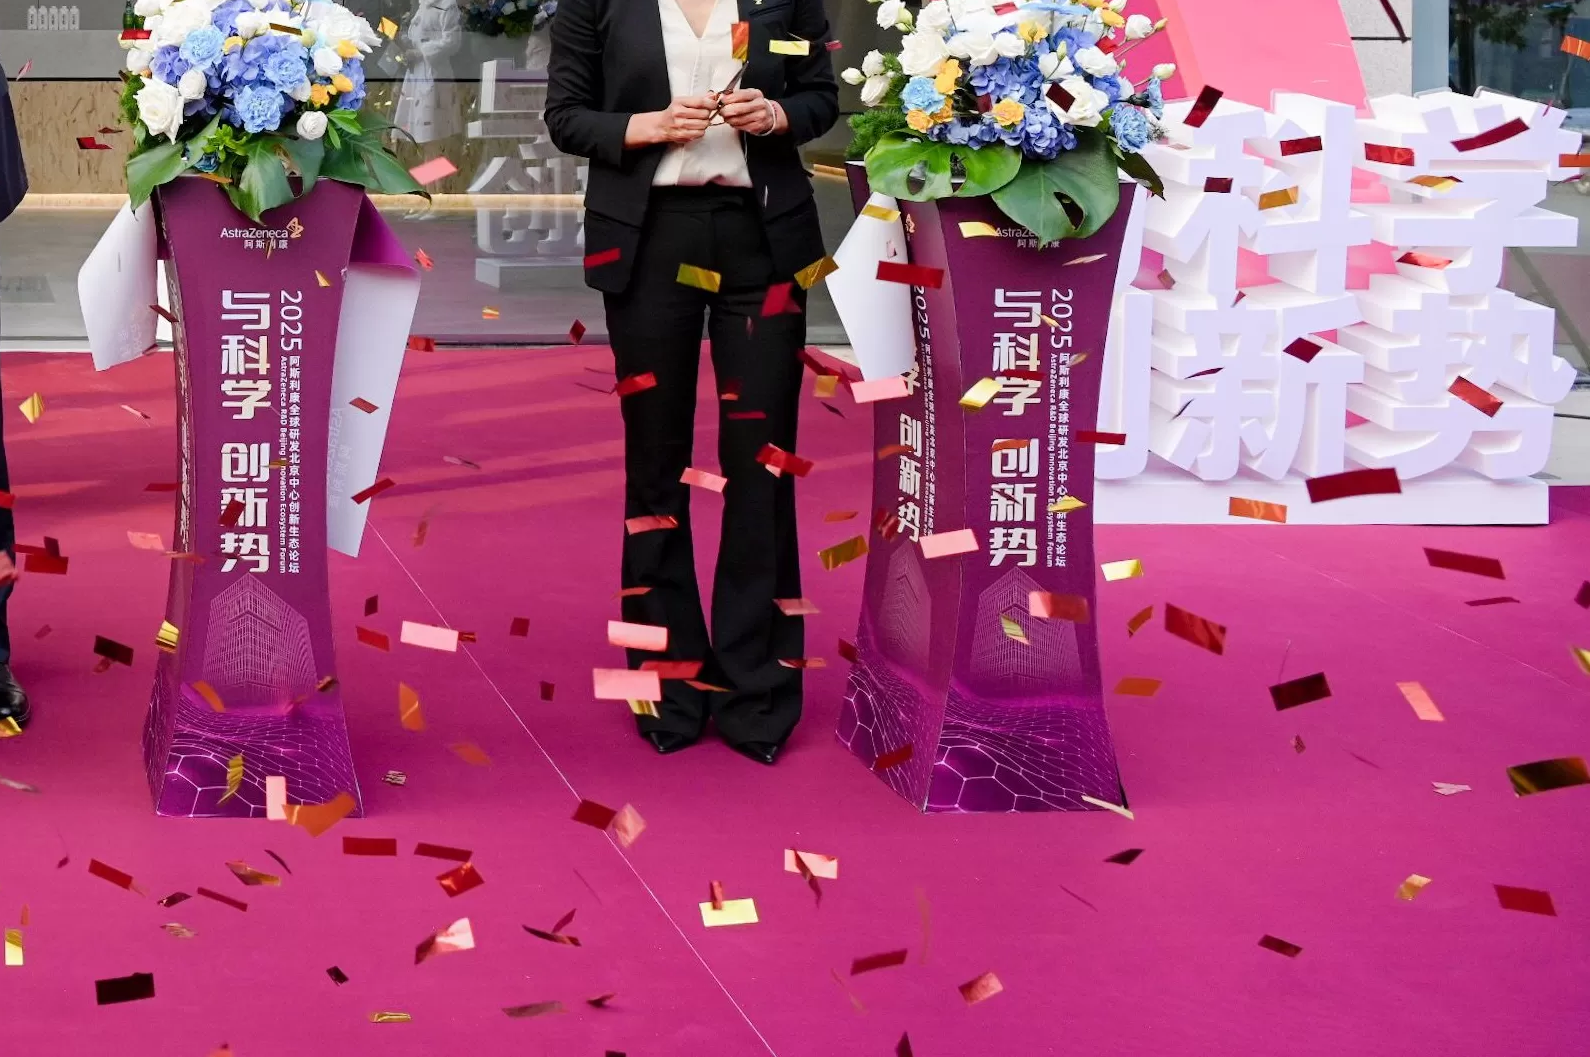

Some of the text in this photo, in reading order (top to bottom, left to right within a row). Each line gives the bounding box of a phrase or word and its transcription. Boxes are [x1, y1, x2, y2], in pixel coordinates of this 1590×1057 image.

[1128, 104, 1579, 296] 科学
[220, 227, 289, 239] AstraZeneca
[1017, 238, 1060, 249] 阿斯康
[280, 356, 288, 407] AstraZeneca
[1049, 352, 1058, 404] AstraZeneca
[220, 289, 272, 574] 与科学 创新势
[279, 427, 288, 456] Beijing
[280, 289, 303, 574] 2025 阿斯利康全球研发北京中心创新生态论坛
[989, 288, 1042, 567] 与科学 创新势
[1050, 288, 1074, 567] 2025 阿斯利康全球研发北京中心新生态论坛
[279, 457, 287, 501] Inovation
[896, 412, 923, 543] 创新势
[1048, 453, 1056, 496] Innovation
[279, 504, 287, 545] Ecosystem
